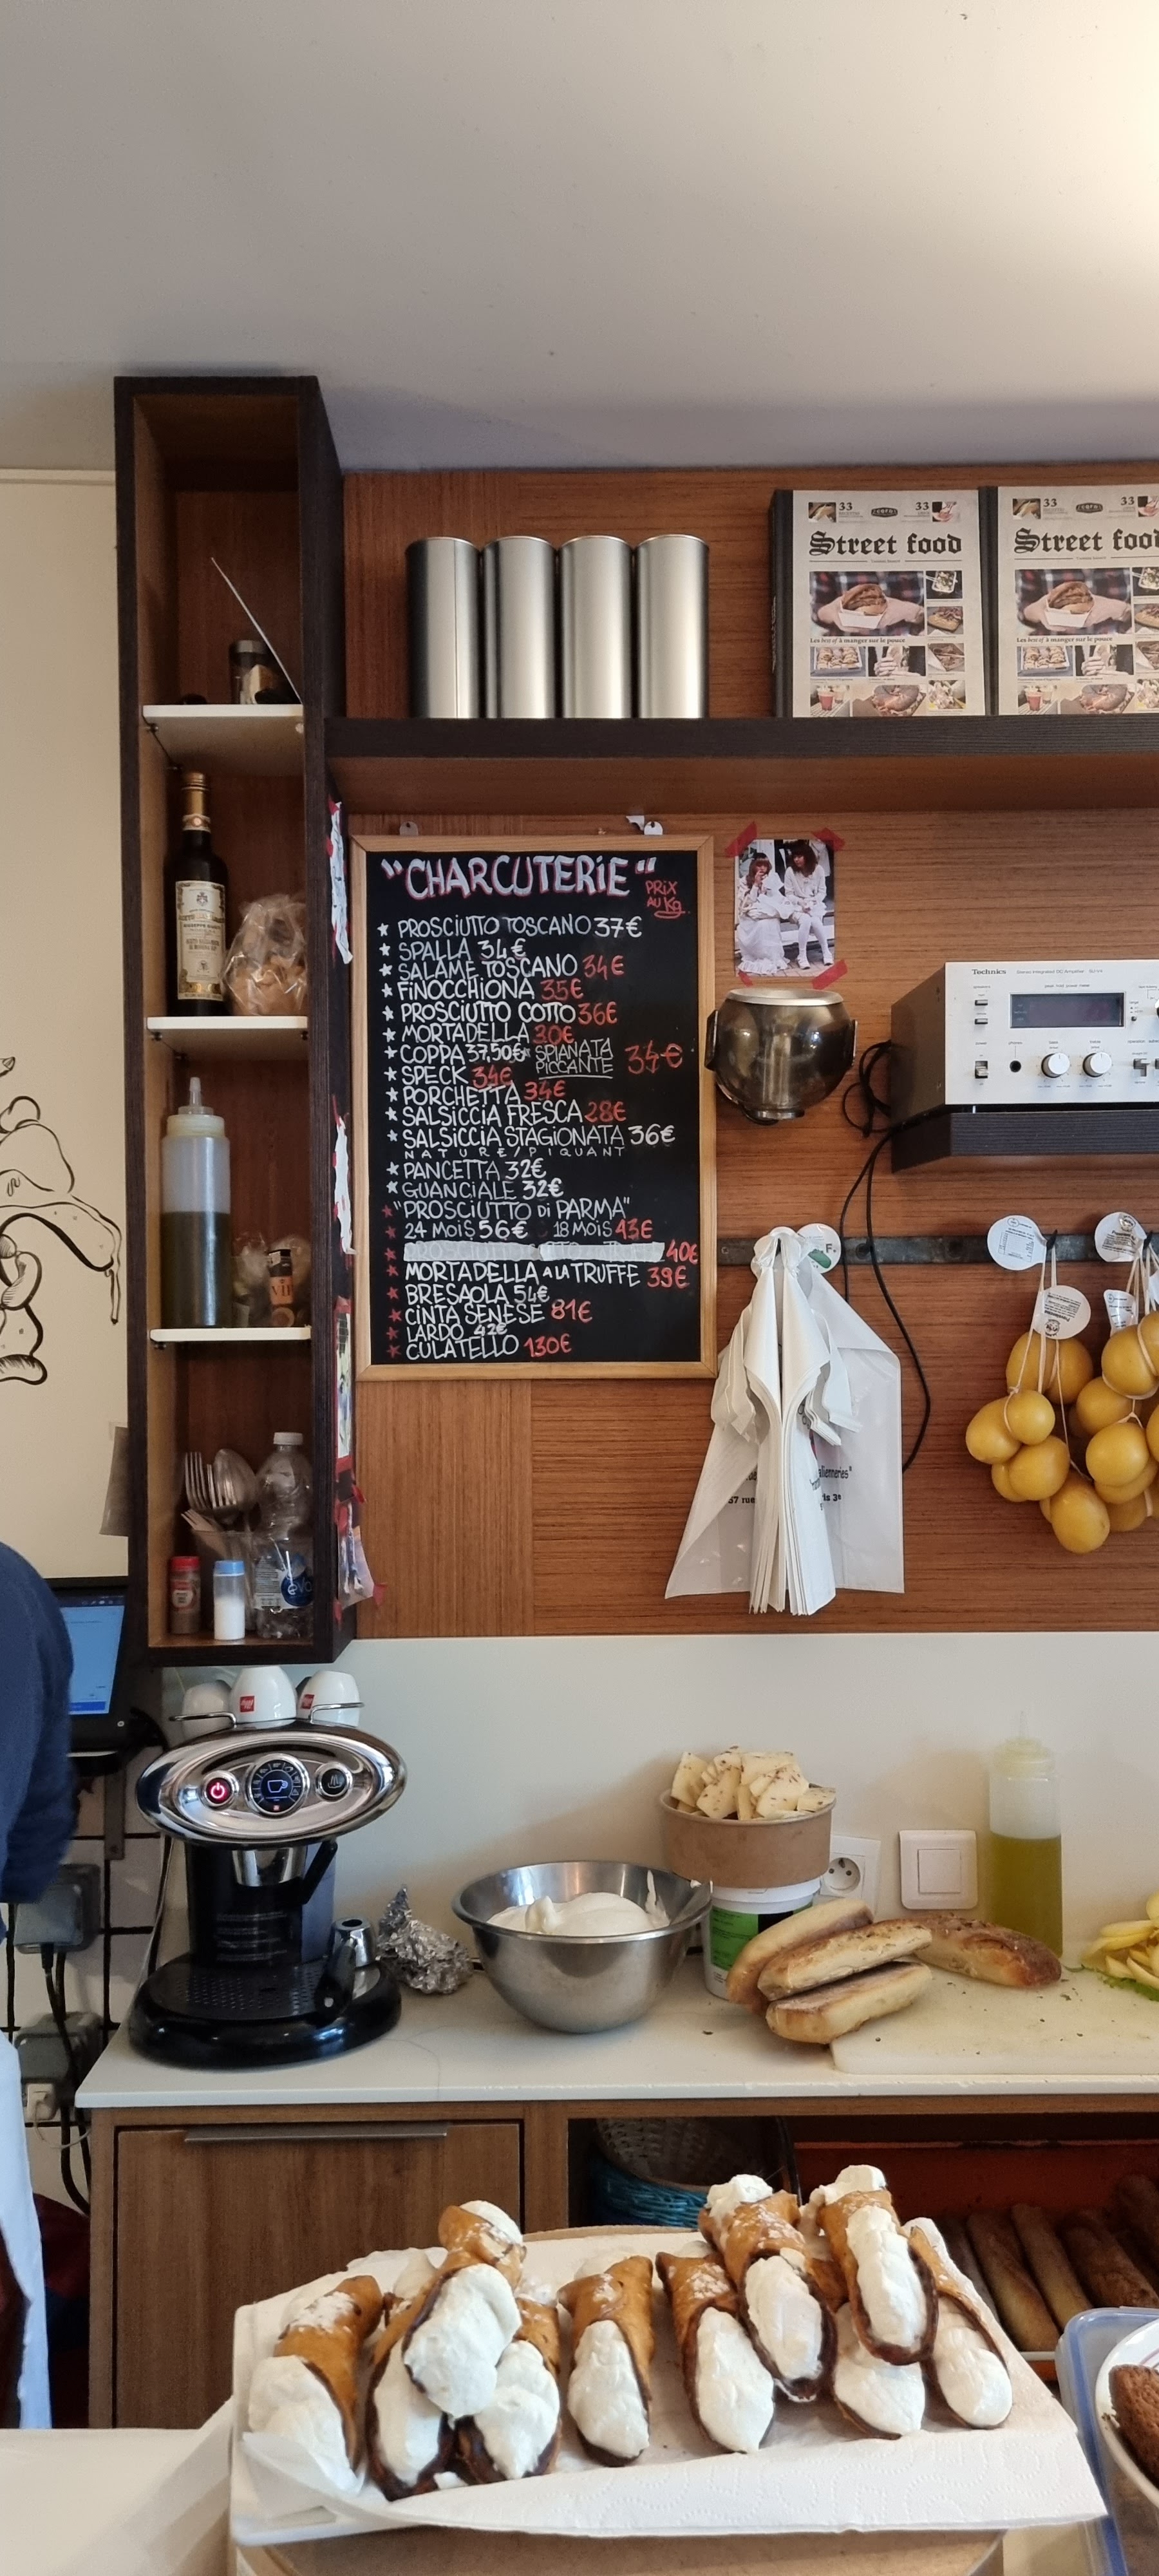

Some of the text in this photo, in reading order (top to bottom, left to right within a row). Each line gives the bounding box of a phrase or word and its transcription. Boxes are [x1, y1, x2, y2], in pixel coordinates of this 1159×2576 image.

[838, 502, 853, 511] 33
[915, 501, 930, 511] 33
[1043, 498, 1057, 507] 33
[1120, 496, 1135, 506] 33
[809, 530, 962, 556] Street food
[1014, 527, 1103, 553] Street
[646, 897, 661, 907] AU
[397, 913, 642, 938] PROSCIUTTO TOSCANO 37€
[399, 938, 471, 961] SPALLA
[398, 958, 479, 980] SALAME
[482, 953, 578, 978] TOSCANO
[397, 977, 584, 1001] FINOCCHIONA 35€
[400, 999, 617, 1025] PROSCIUTTO COTTO 36€
[402, 1021, 574, 1045] MORTADELLA 30€
[400, 1044, 466, 1065] COPPA
[535, 1037, 614, 1062] SPIANATA
[401, 1065, 513, 1089] SPECK 34€
[536, 1056, 614, 1074] PICCANTE
[402, 1079, 566, 1107] PORCHETTA 34€
[402, 1099, 627, 1128] SALSICCIA FRESCA 28€
[402, 1123, 675, 1149] SALSICCIA STAGIONATA 36€
[403, 1157, 547, 1181] PANCETTA 32€
[402, 1177, 564, 1200] GUANCIALE 32€
[404, 1220, 428, 1239] 24
[478, 1220, 528, 1239] 56€
[552, 1221, 569, 1238] 18
[615, 1218, 653, 1240] 43€
[666, 1238, 699, 1265] 40€
[405, 1261, 690, 1288] MORTADELLA A LA TRUFFE 39€
[405, 1282, 550, 1305] BRESAOLA 54€
[405, 1298, 593, 1325] CINTA SENESE 81€
[406, 1322, 508, 1343] LARDO 42€
[406, 1332, 572, 1360] CULATELLO 130€
